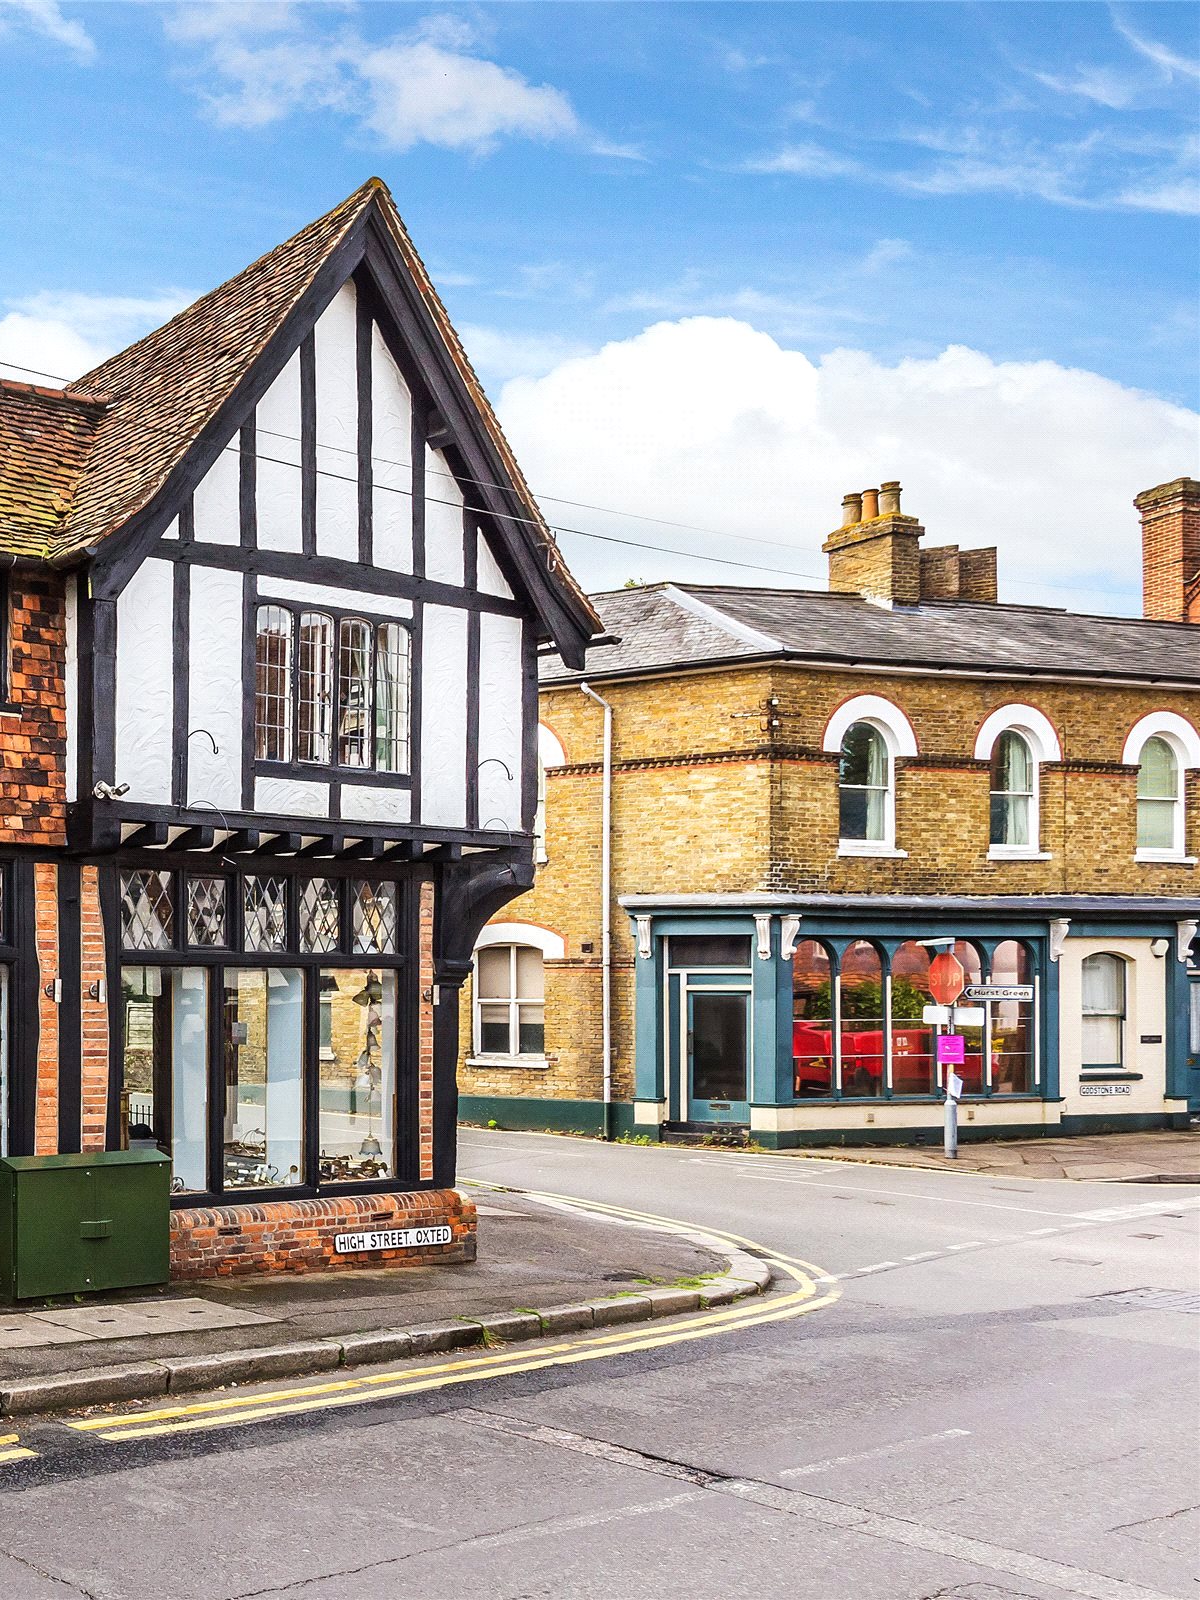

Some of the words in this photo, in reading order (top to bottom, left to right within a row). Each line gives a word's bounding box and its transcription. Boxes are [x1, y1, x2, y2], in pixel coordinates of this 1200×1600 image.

[1082, 1087, 1113, 1095] GODSTONE
[1115, 1086, 1130, 1094] ROAD
[338, 1235, 365, 1251] HIGH
[416, 1228, 449, 1244] OXTED
